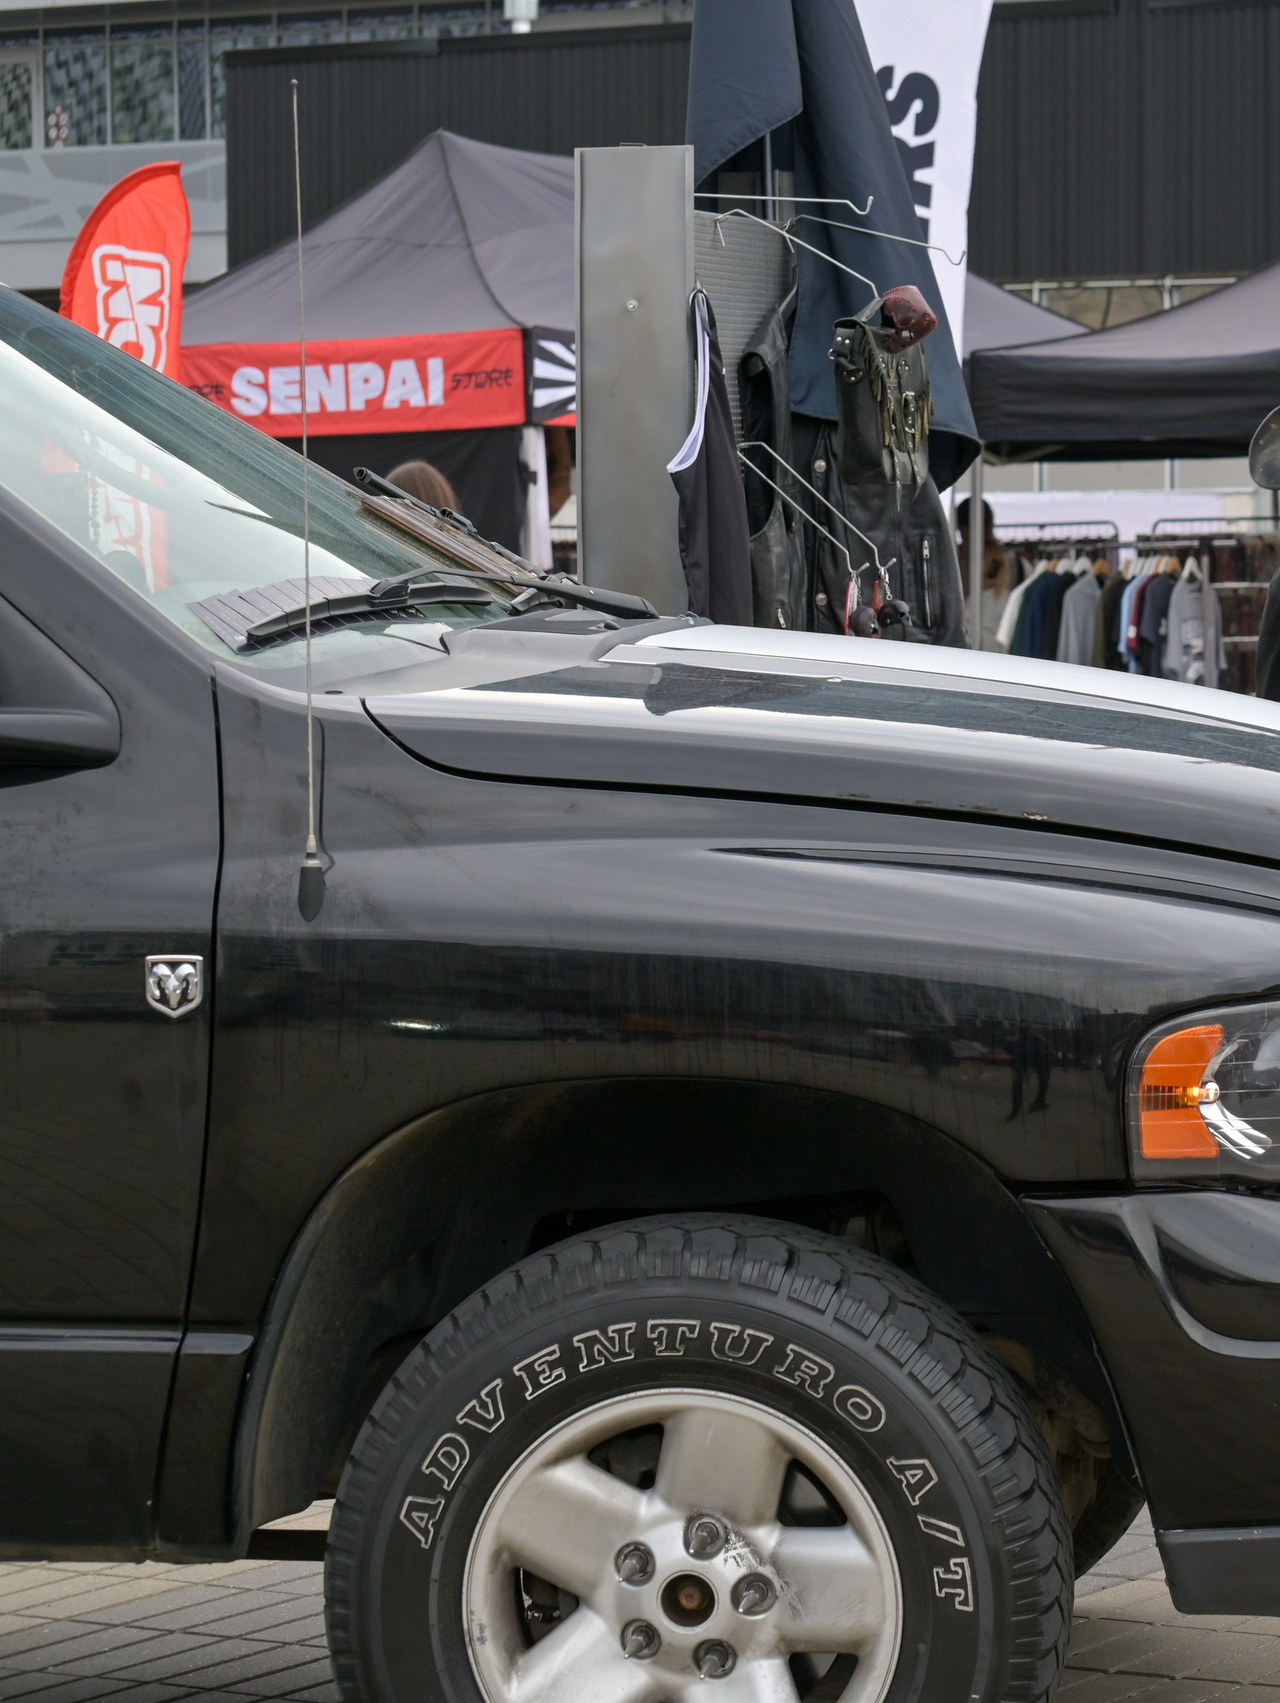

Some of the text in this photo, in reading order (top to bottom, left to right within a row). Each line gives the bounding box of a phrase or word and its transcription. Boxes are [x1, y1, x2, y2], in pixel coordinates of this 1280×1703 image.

[230, 357, 445, 416] SENPAI
[400, 1318, 974, 1612] ADVENTURO A/T
